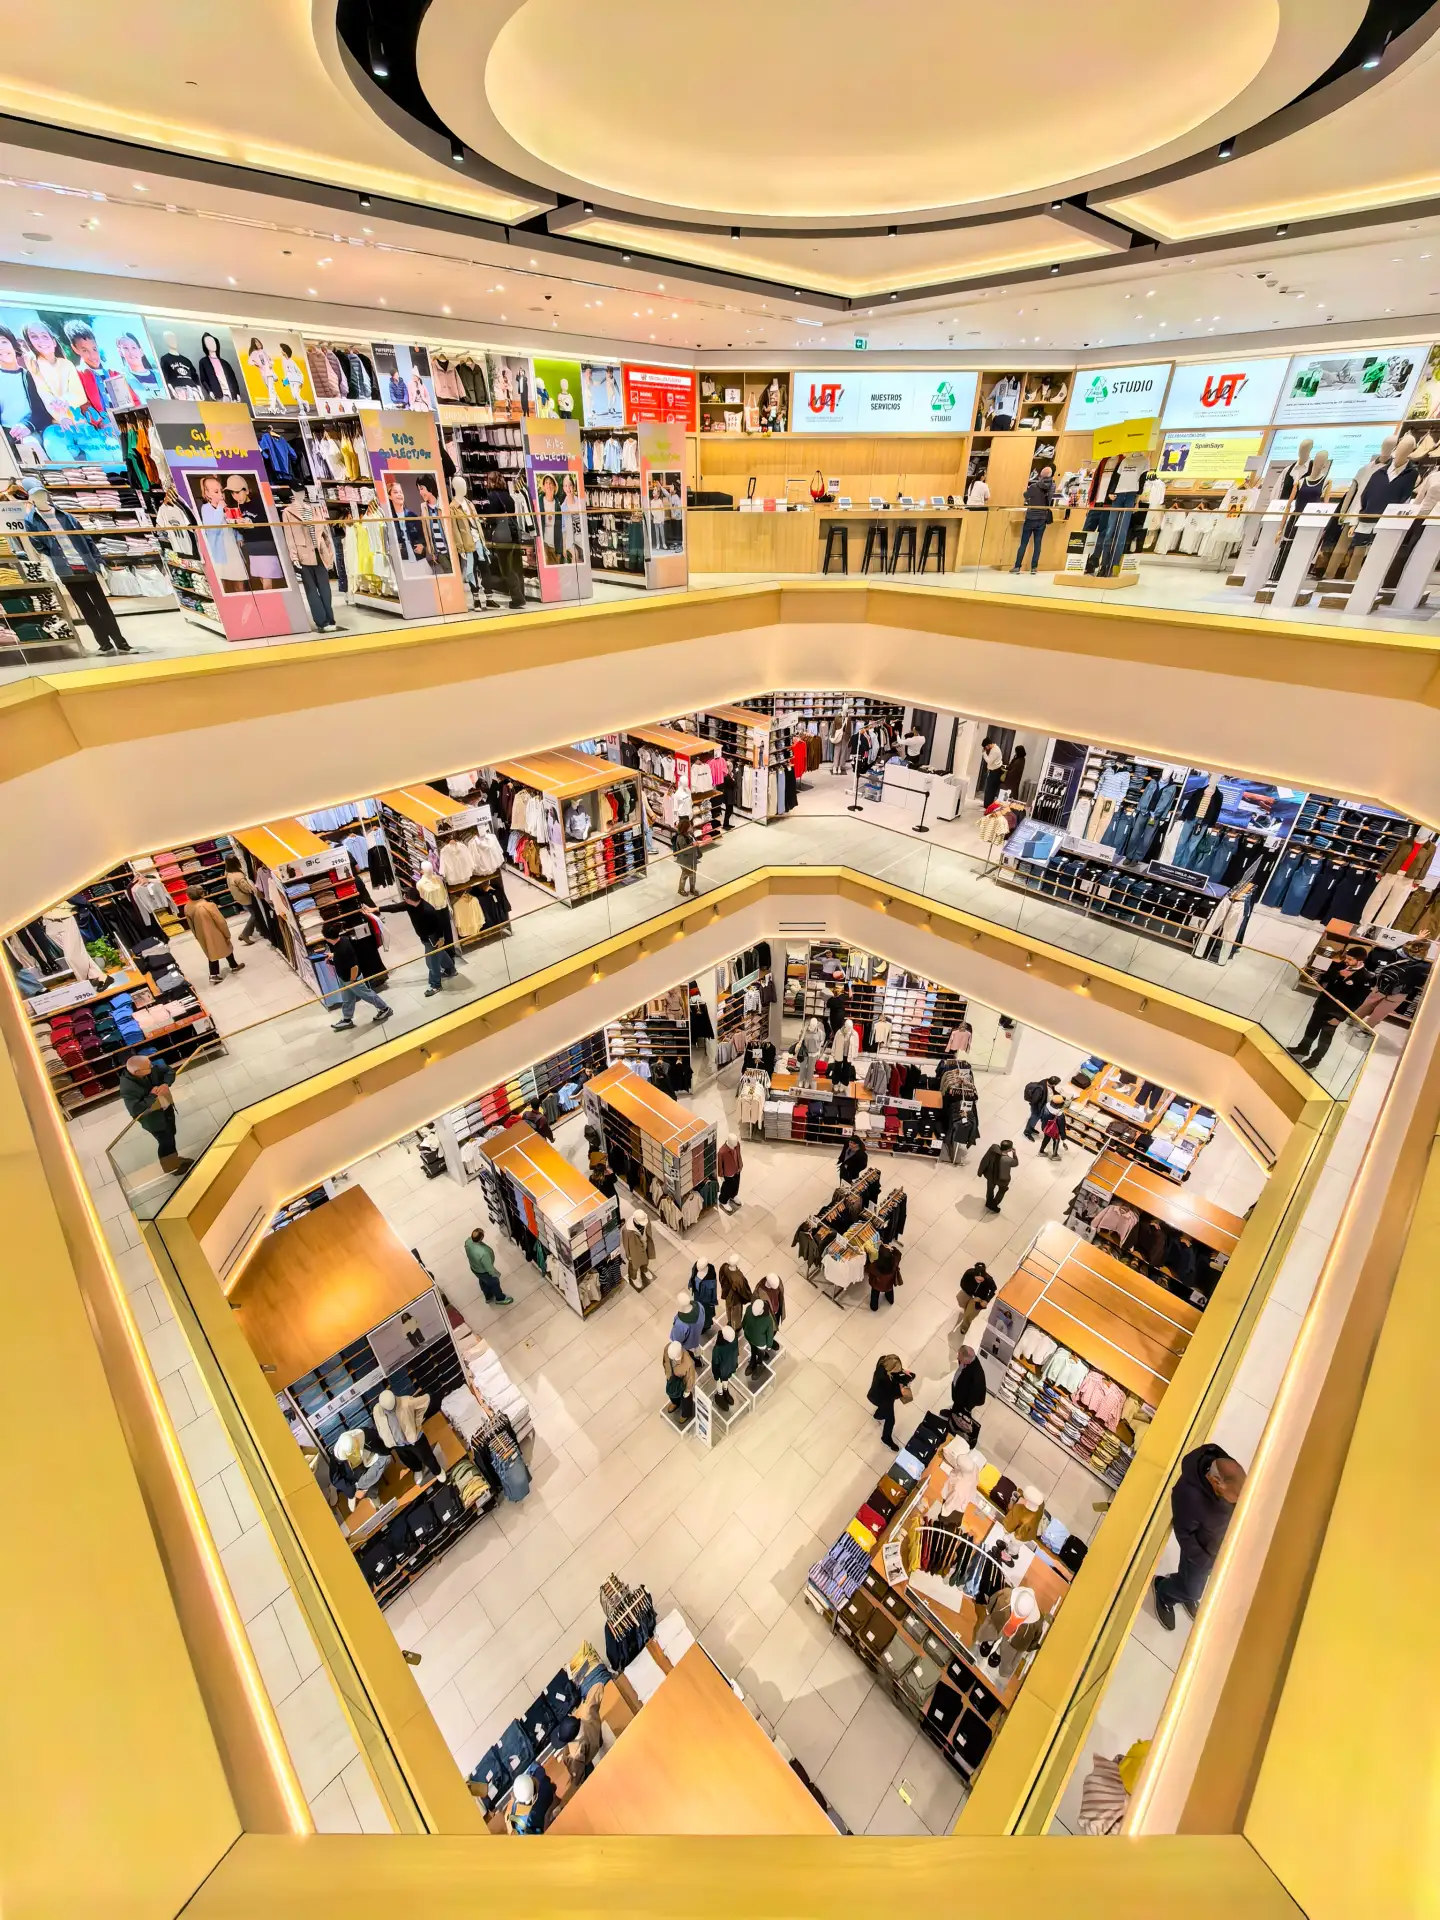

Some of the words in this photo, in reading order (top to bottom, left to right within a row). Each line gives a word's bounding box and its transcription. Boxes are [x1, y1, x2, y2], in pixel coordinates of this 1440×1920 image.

[1112, 379, 1153, 394] STUDIO
[1201, 373, 1246, 408] UT
[810, 383, 842, 413] UT
[870, 394, 902, 402] NUESTROS
[870, 403, 901, 411] SERVICIOS
[392, 433, 414, 446] KIDS
[545, 437, 564, 449] KIDS
[1195, 442, 1224, 450] SpainSays
[378, 447, 431, 460] COLLECTION
[607, 734, 618, 746] UT
[678, 762, 687, 773] UT
[1024, 821, 1045, 832] UNIQLO
